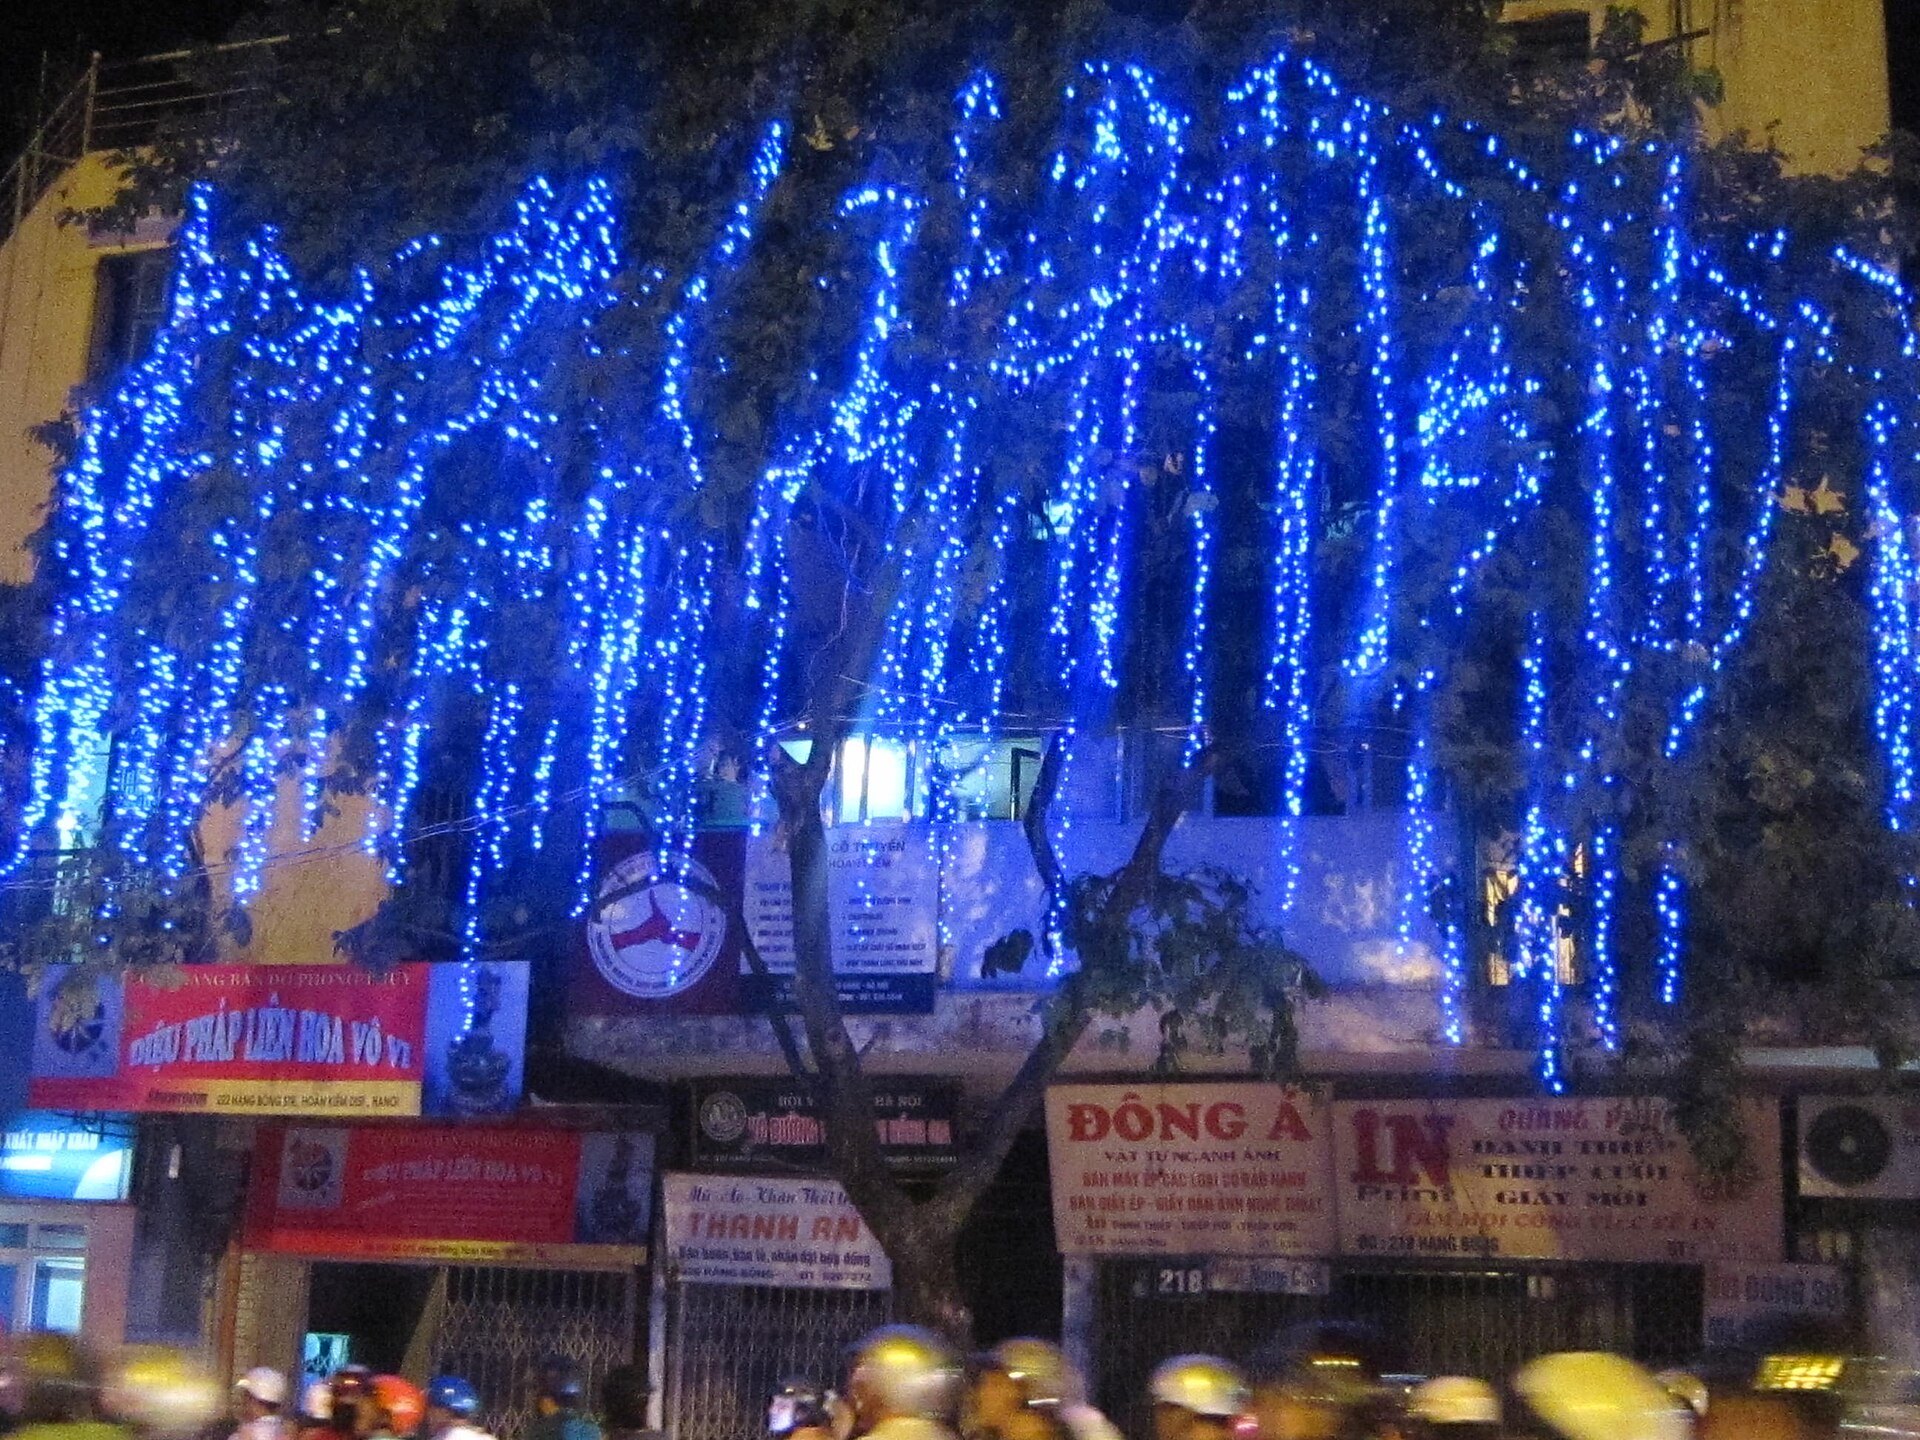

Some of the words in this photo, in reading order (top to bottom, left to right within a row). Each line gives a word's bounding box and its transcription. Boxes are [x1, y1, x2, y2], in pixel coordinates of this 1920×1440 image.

[297, 1009, 346, 1065] HOA
[1066, 1091, 1249, 1142] ĐÔNG
[1349, 1108, 1455, 1186] IN
[688, 1211, 800, 1241] THANH
[811, 1214, 861, 1243] AN
[1158, 1268, 1203, 1293] 218
